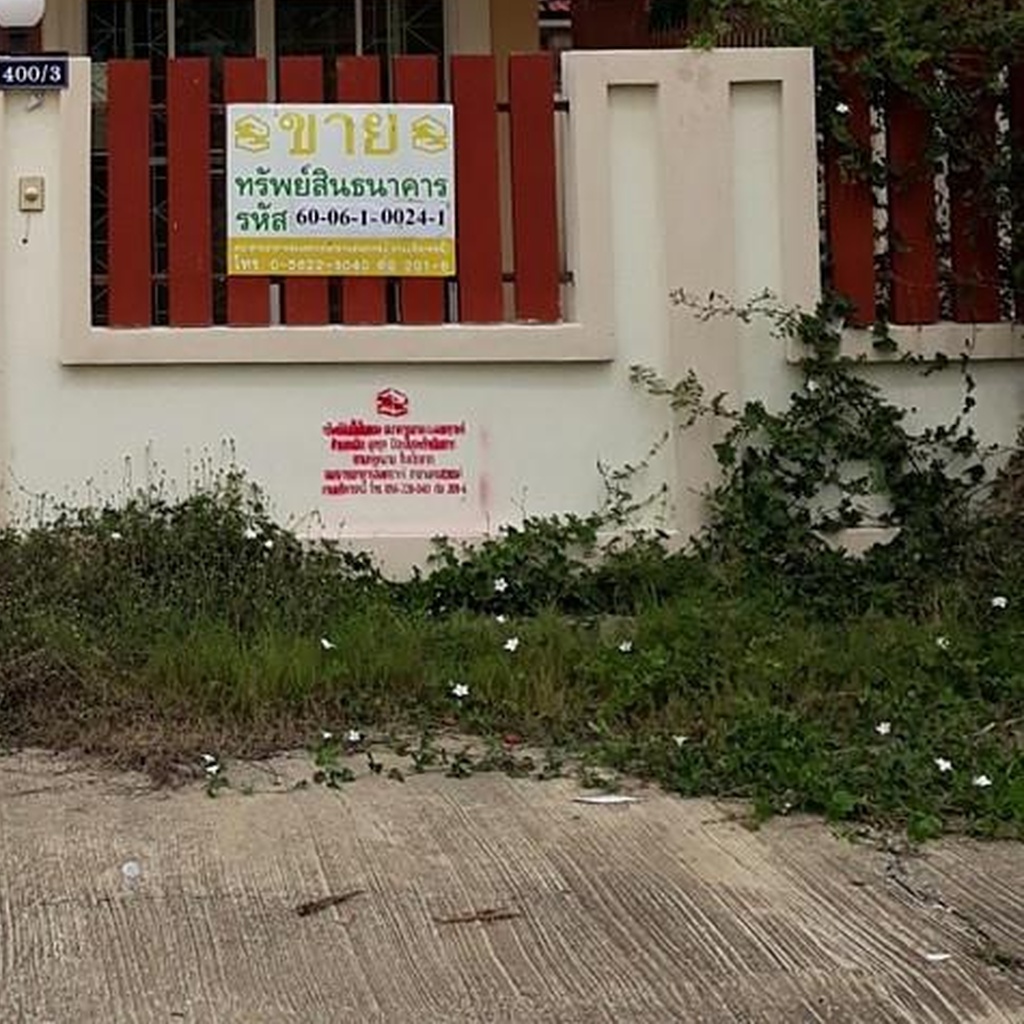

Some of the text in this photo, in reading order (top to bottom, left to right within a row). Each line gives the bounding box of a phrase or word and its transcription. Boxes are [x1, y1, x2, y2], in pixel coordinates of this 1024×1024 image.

[2, 64, 61, 83] 400/3
[278, 112, 399, 156] ขาย
[235, 164, 448, 198] ทรัพย์สินธนาคาร
[236, 202, 446, 232] รหัส 60-06-1-0024-1
